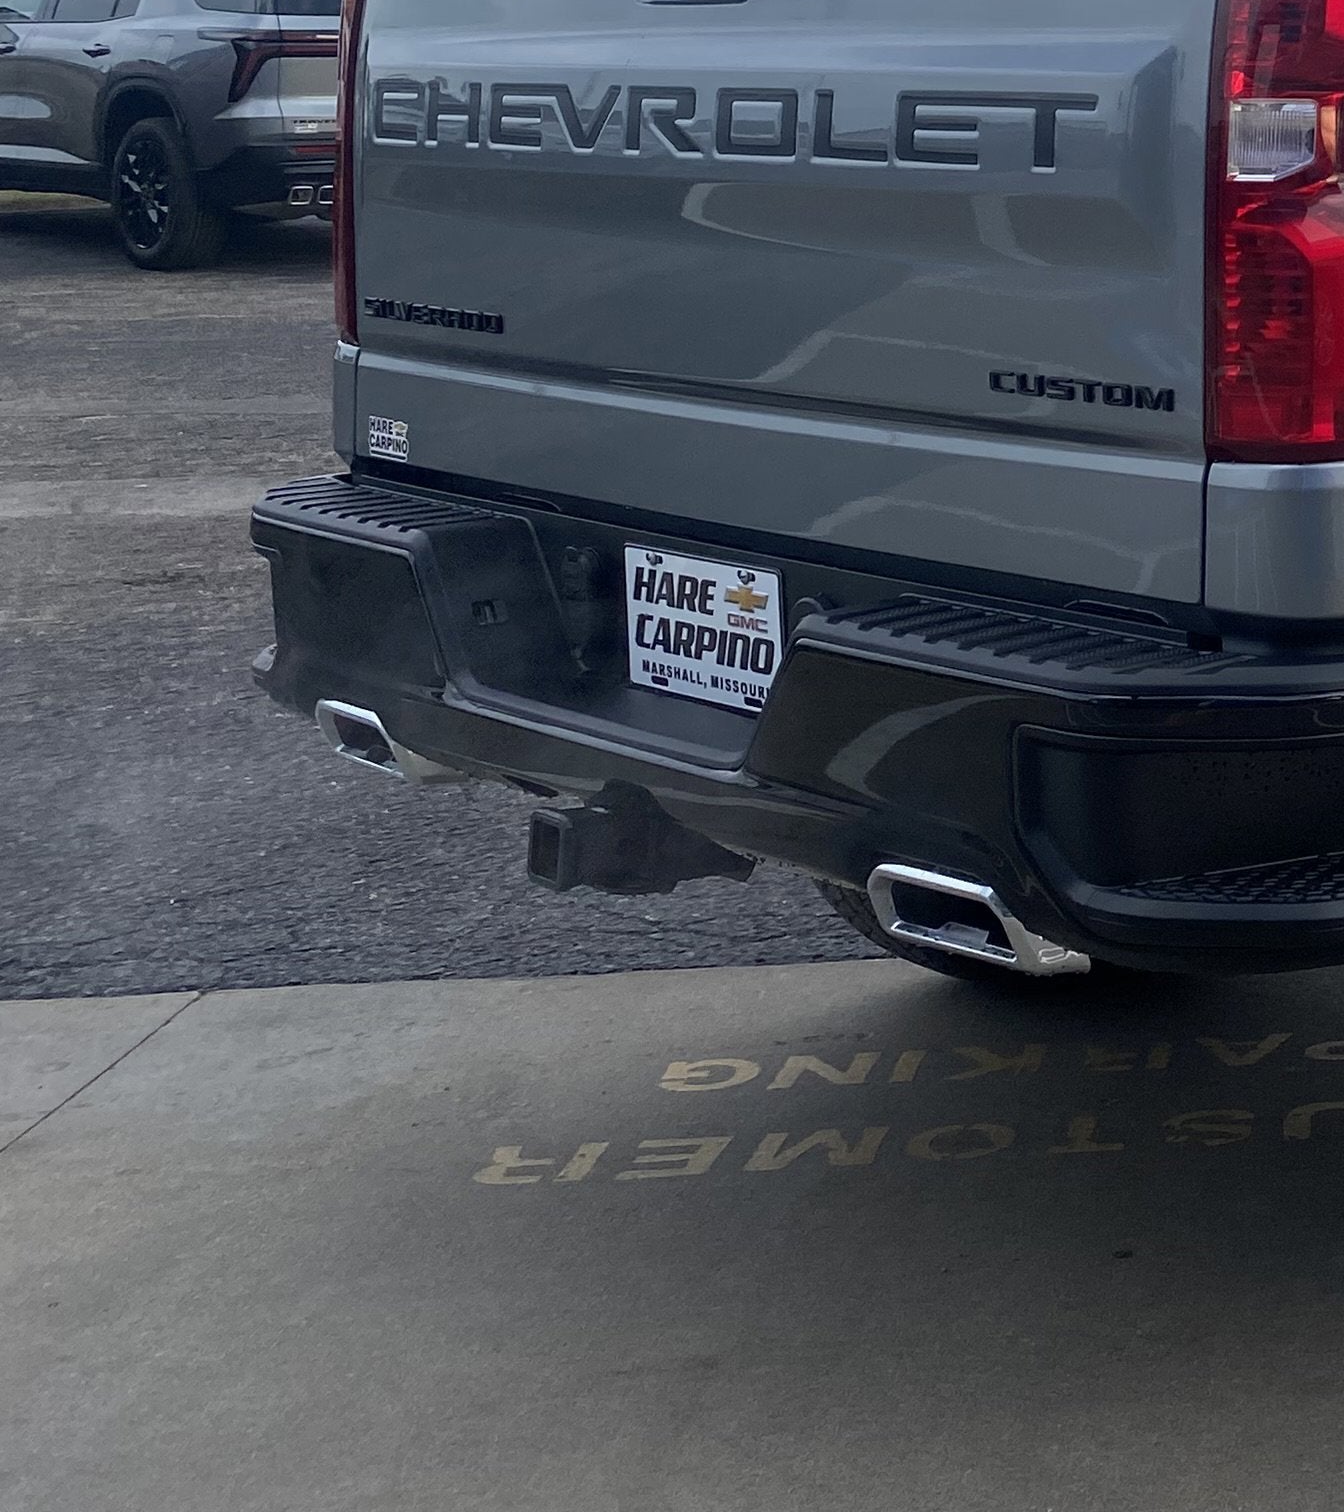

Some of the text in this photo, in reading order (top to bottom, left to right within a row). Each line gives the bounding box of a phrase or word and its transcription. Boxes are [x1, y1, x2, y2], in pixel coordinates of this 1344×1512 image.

[371, 78, 1099, 174] CHEVROLET
[364, 296, 504, 335] SILVERADO
[988, 370, 1176, 413] CUSTOM
[369, 417, 394, 435] HARE
[369, 434, 408, 454] CARPINO
[633, 566, 717, 616] HARE
[726, 612, 769, 634] GMC
[634, 612, 776, 676] CARPINO
[641, 658, 707, 689] MARSHALL,
